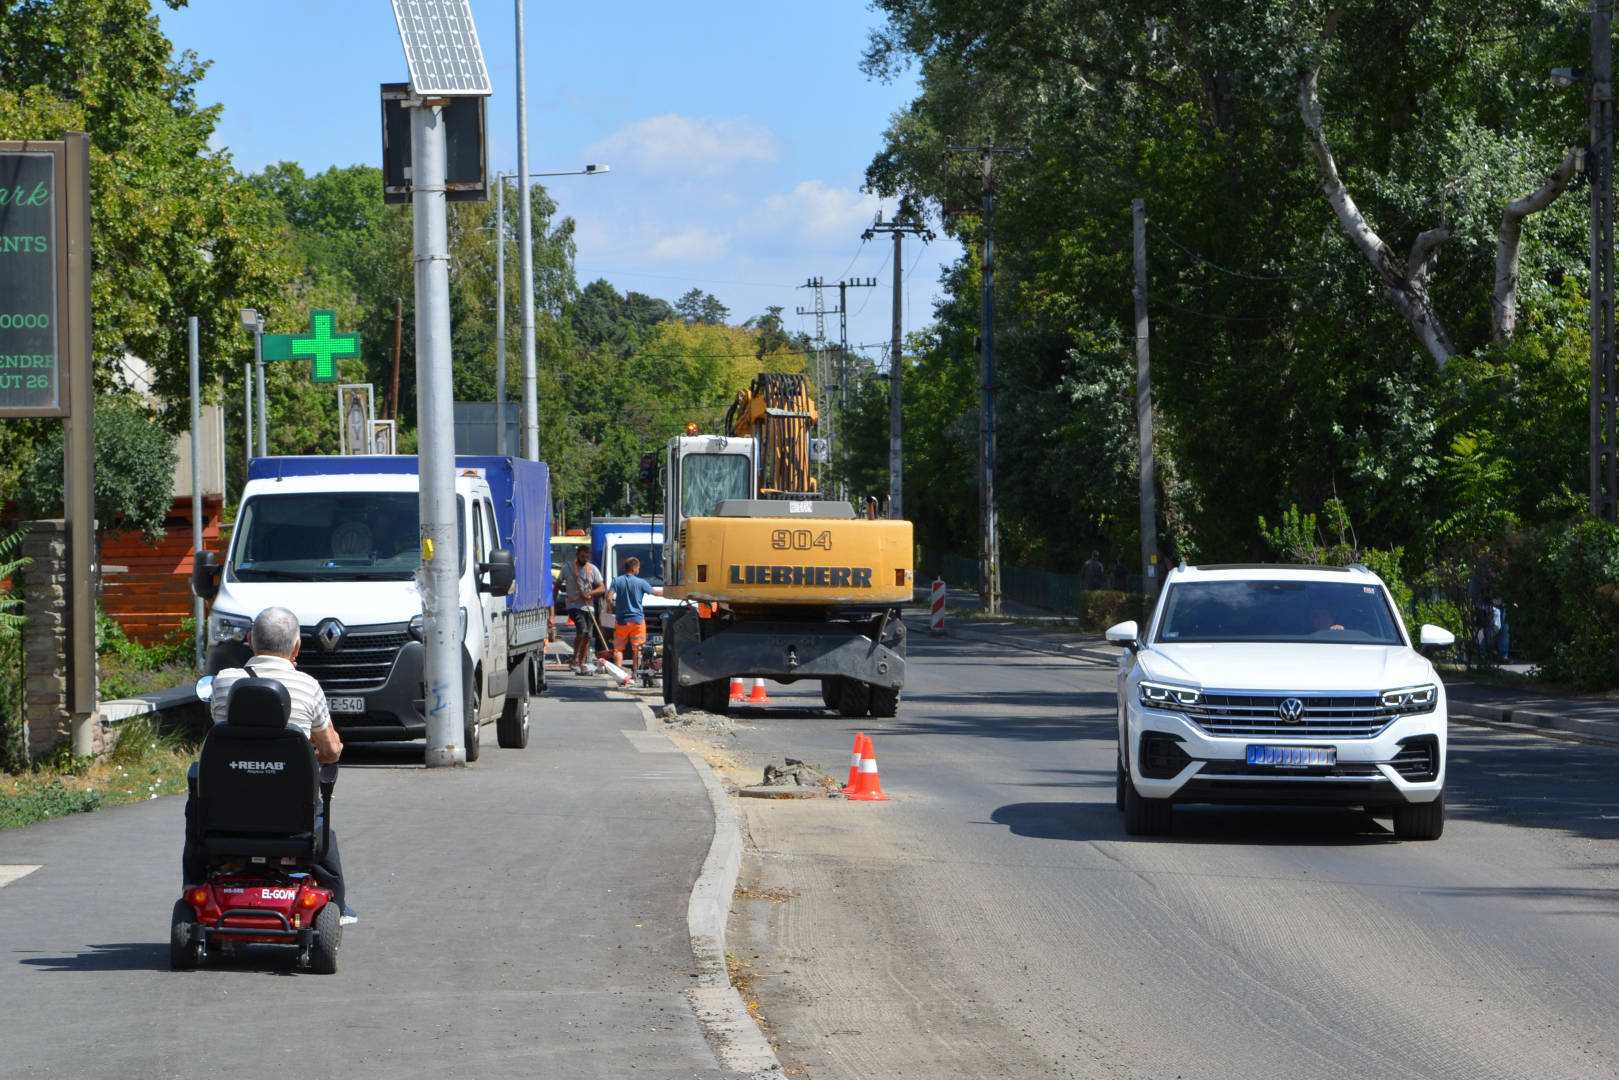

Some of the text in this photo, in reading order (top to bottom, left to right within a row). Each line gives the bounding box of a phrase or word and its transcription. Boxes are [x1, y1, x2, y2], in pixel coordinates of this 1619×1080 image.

[0, 236, 47, 252] NTS
[772, 529, 832, 550] 904
[730, 564, 873, 588] LIEBHERR
